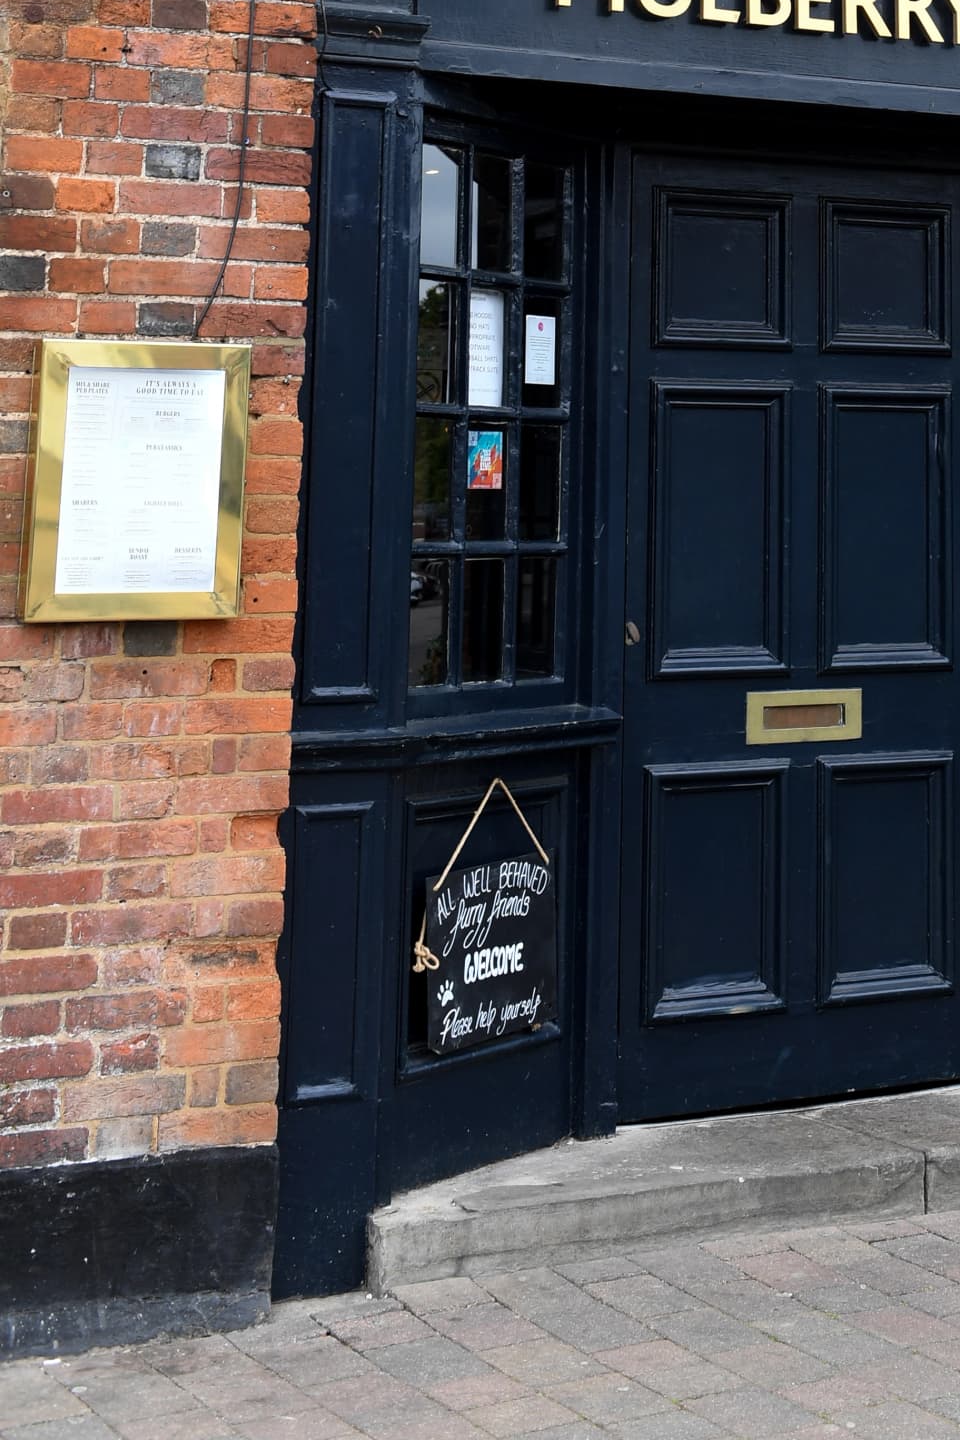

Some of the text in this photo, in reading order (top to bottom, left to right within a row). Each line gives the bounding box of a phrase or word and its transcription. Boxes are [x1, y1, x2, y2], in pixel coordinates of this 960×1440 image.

[437, 861, 548, 925] ALL WELL BEHAVED
[442, 889, 531, 957] furry friends
[464, 942, 524, 984] WELCOME
[440, 986, 542, 1046] Please help yourself
